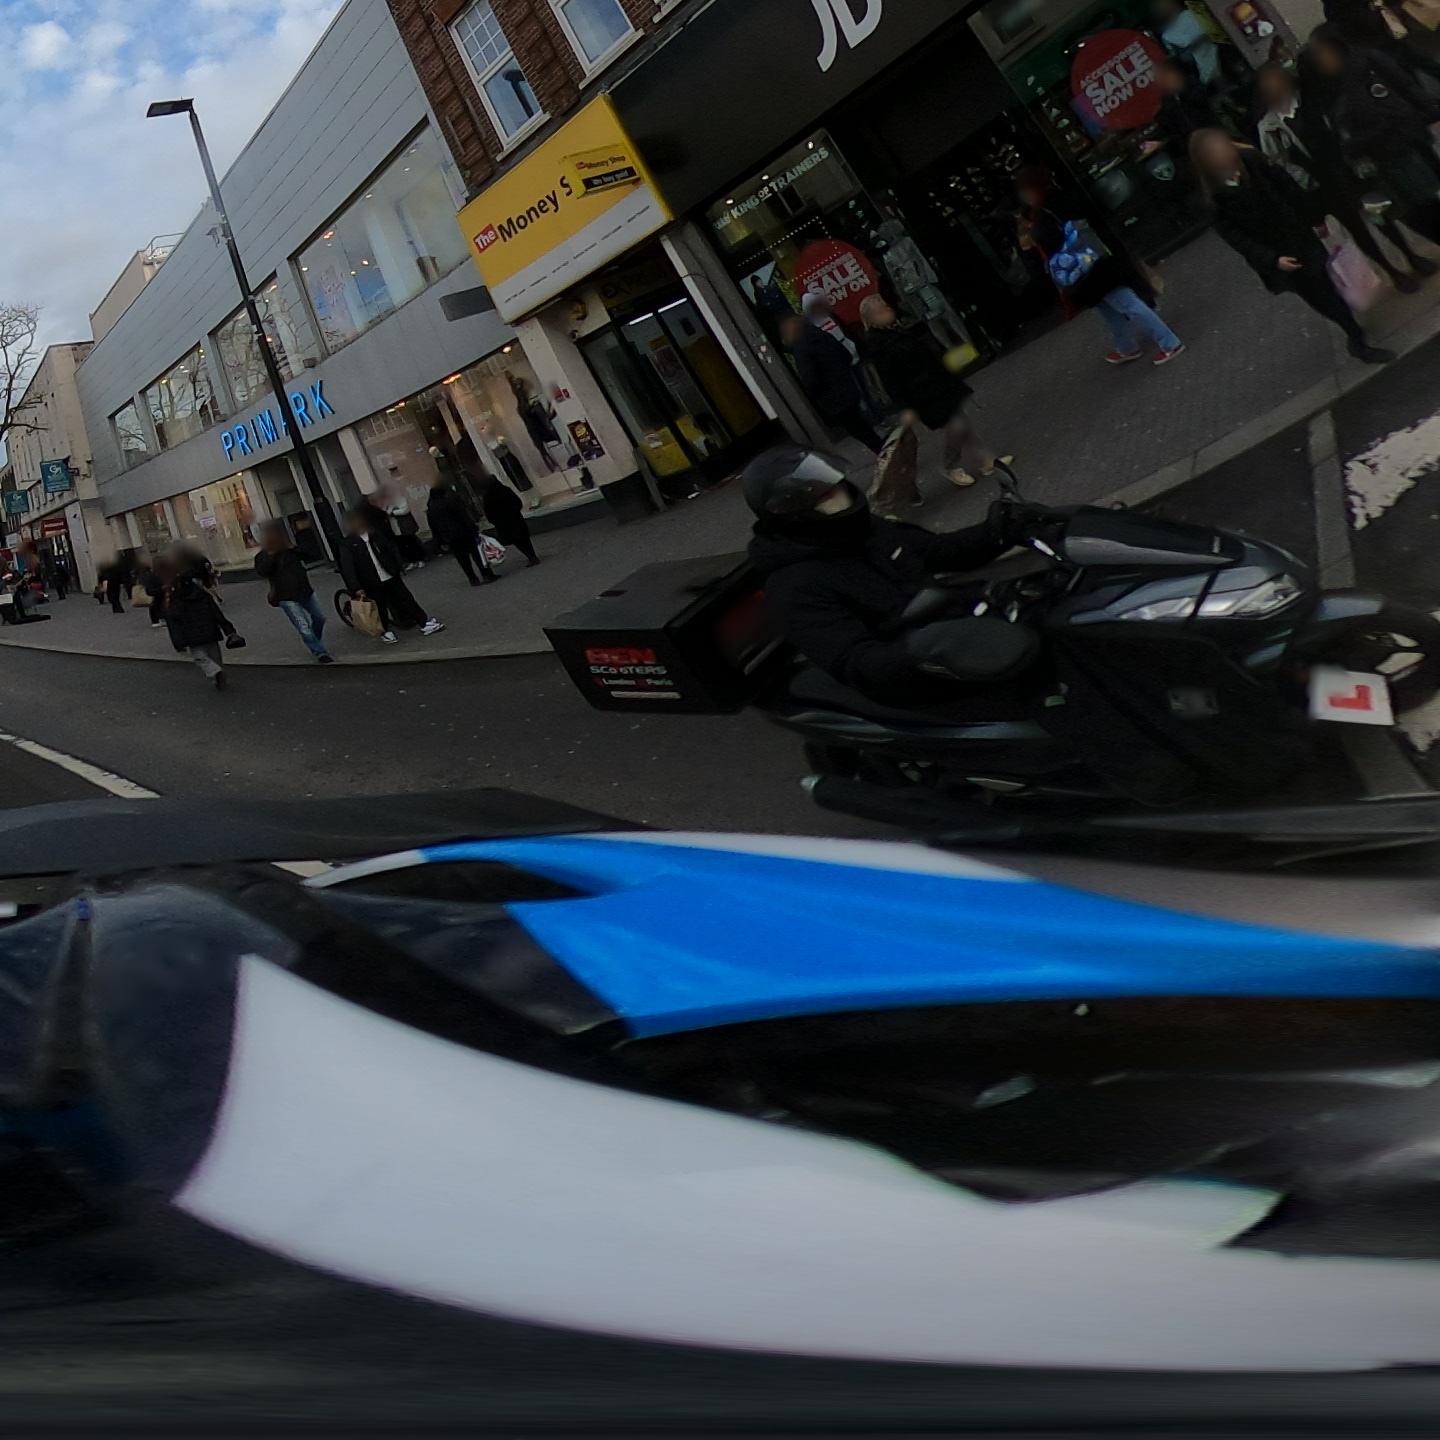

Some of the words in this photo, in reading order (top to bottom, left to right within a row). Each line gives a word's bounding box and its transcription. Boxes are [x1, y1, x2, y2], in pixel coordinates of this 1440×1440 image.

[1080, 46, 1156, 106] SALE
[1091, 81, 1138, 118] NOW
[768, 146, 831, 193] TRAINERS
[474, 229, 496, 250] The
[497, 189, 560, 242] Money
[805, 257, 865, 301] SALE
[1328, 684, 1374, 711] L
